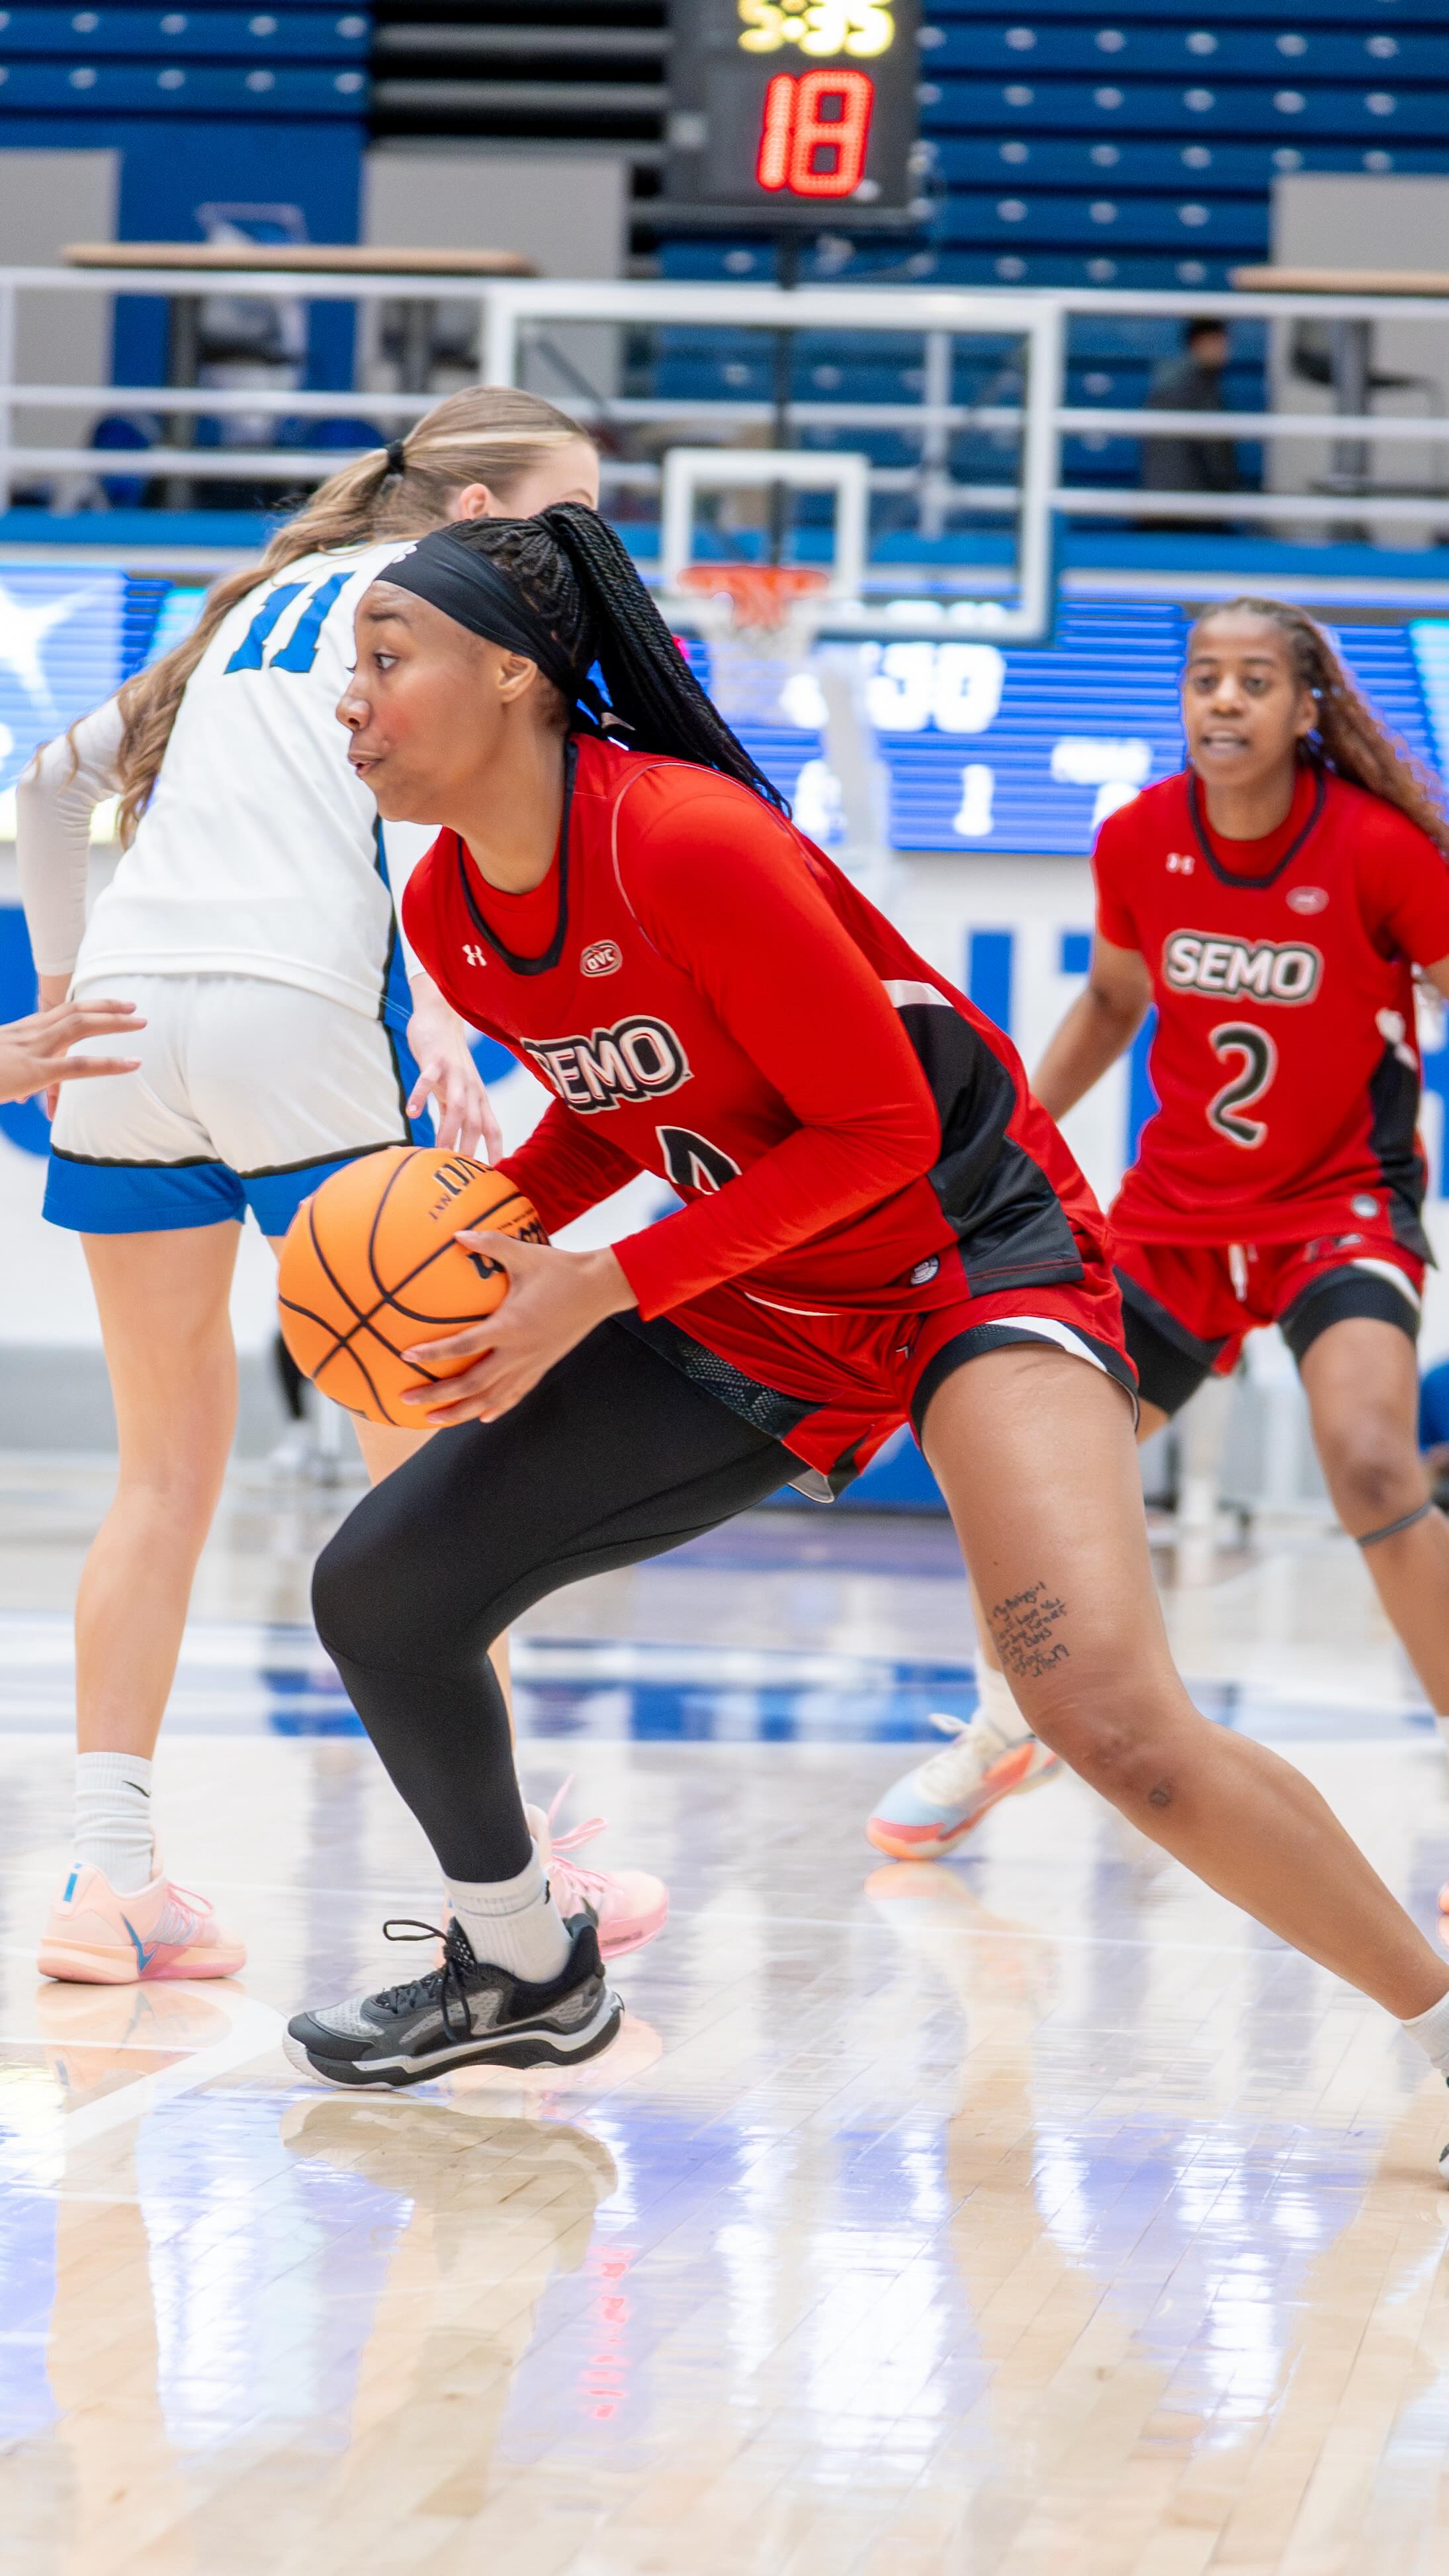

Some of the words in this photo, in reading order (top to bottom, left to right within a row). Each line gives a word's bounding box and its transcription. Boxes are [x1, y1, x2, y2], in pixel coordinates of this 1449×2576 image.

[756, 69, 875, 198] 18
[223, 571, 358, 675] 11
[586, 948, 616, 970] OVC
[1163, 928, 1323, 1006] SEMO
[521, 1015, 695, 1115] EMO
[1206, 1021, 1278, 1149] 2
